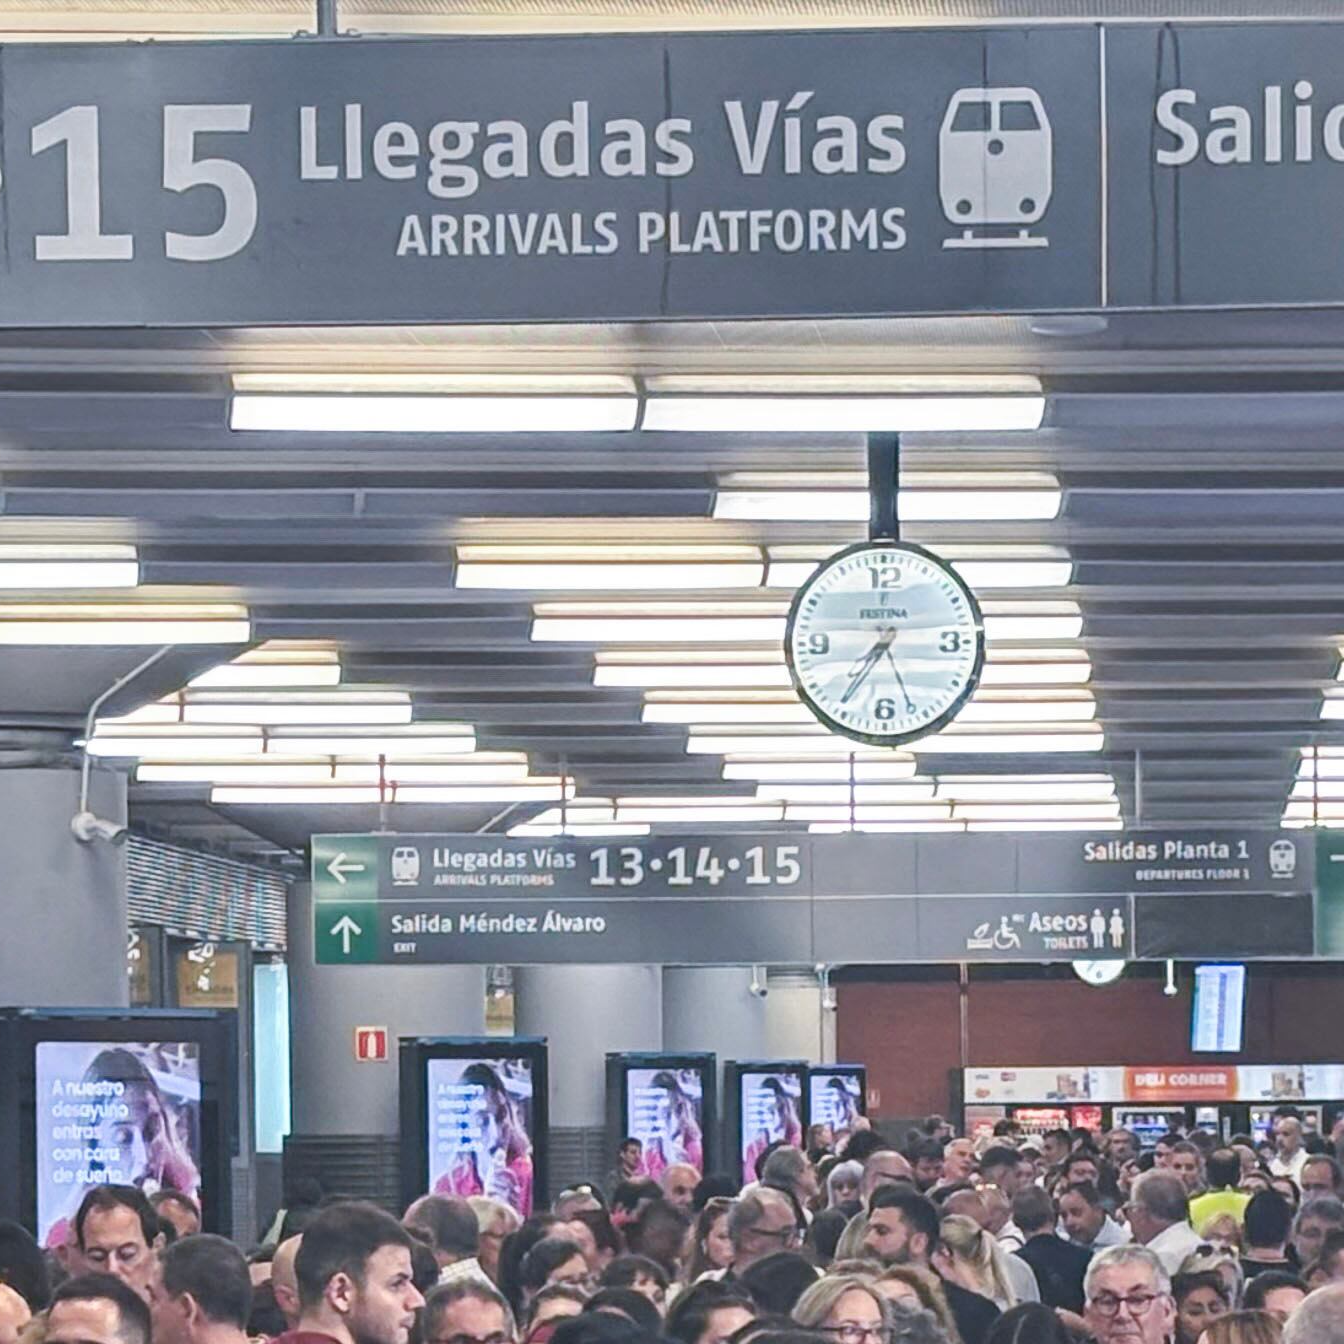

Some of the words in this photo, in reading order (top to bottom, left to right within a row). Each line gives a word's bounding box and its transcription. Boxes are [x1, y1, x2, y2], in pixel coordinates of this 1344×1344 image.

[301, 101, 694, 198] Llegadas
[725, 91, 906, 174] Vías
[397, 211, 619, 256] ARRIVALS
[639, 206, 907, 254] PLATFORMS
[868, 567, 902, 589] 12
[860, 608, 908, 620] FESTINA
[809, 633, 829, 655] 9
[939, 631, 960, 653] 3
[875, 698, 895, 720] 6
[433, 848, 528, 872] Llegadas
[532, 847, 577, 869] Vías
[1084, 840, 1157, 861] Salidas
[1164, 839, 1230, 859] Planta
[1237, 839, 1250, 859] 1
[433, 874, 487, 887] ARRIVALS
[490, 874, 555, 886] PLATFORMS
[1135, 869, 1204, 881] DEPARTURES
[1207, 868, 1241, 880] FLOOR
[392, 914, 453, 934] Salida
[459, 912, 538, 934] Méndez
[542, 909, 606, 934] Álvaro
[1028, 912, 1089, 932] Aseos
[393, 942, 417, 954] EXIT
[1043, 935, 1089, 949] TOILETS
[52, 1080, 64, 1096] A
[66, 1081, 125, 1096] nuestro
[53, 1169, 73, 1183] de
